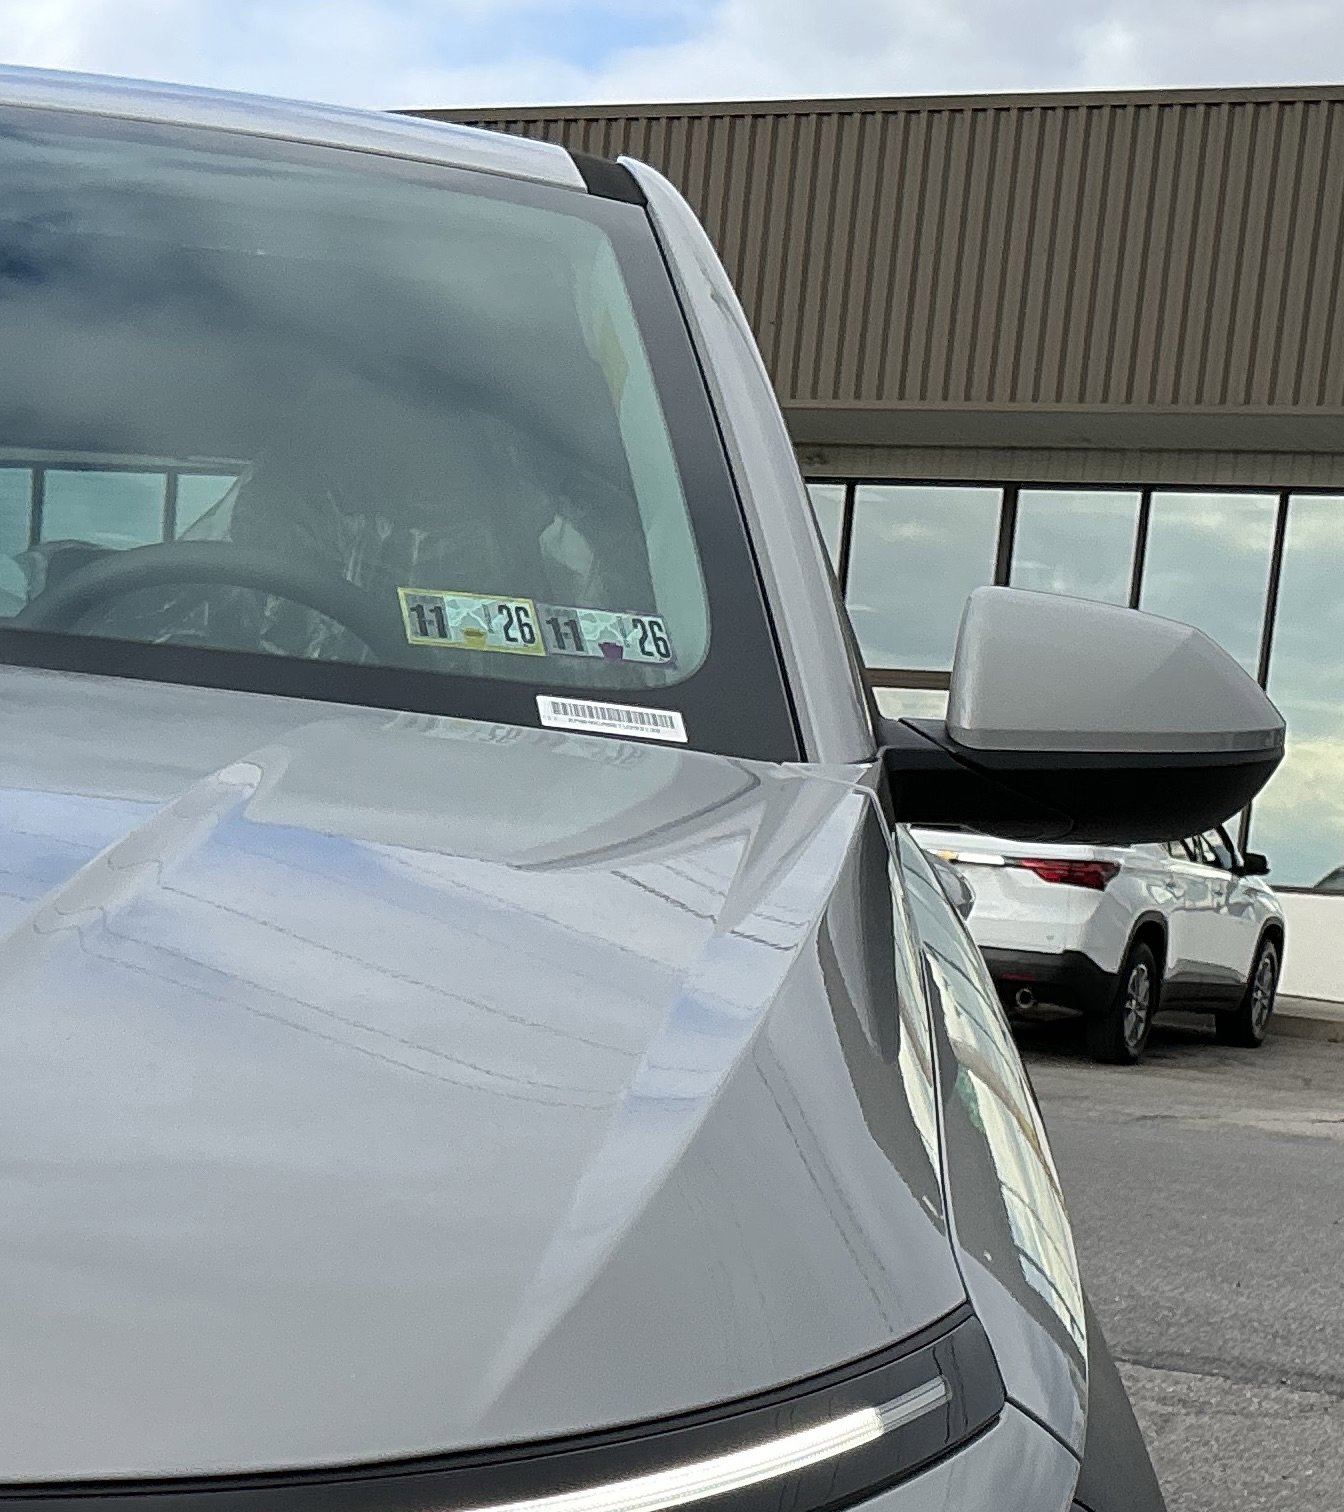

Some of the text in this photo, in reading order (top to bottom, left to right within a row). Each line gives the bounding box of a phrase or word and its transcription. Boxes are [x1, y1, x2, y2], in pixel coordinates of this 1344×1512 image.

[410, 604, 448, 638] 11
[498, 604, 536, 644] 26
[546, 617, 585, 652] 11
[632, 618, 671, 658] 26
